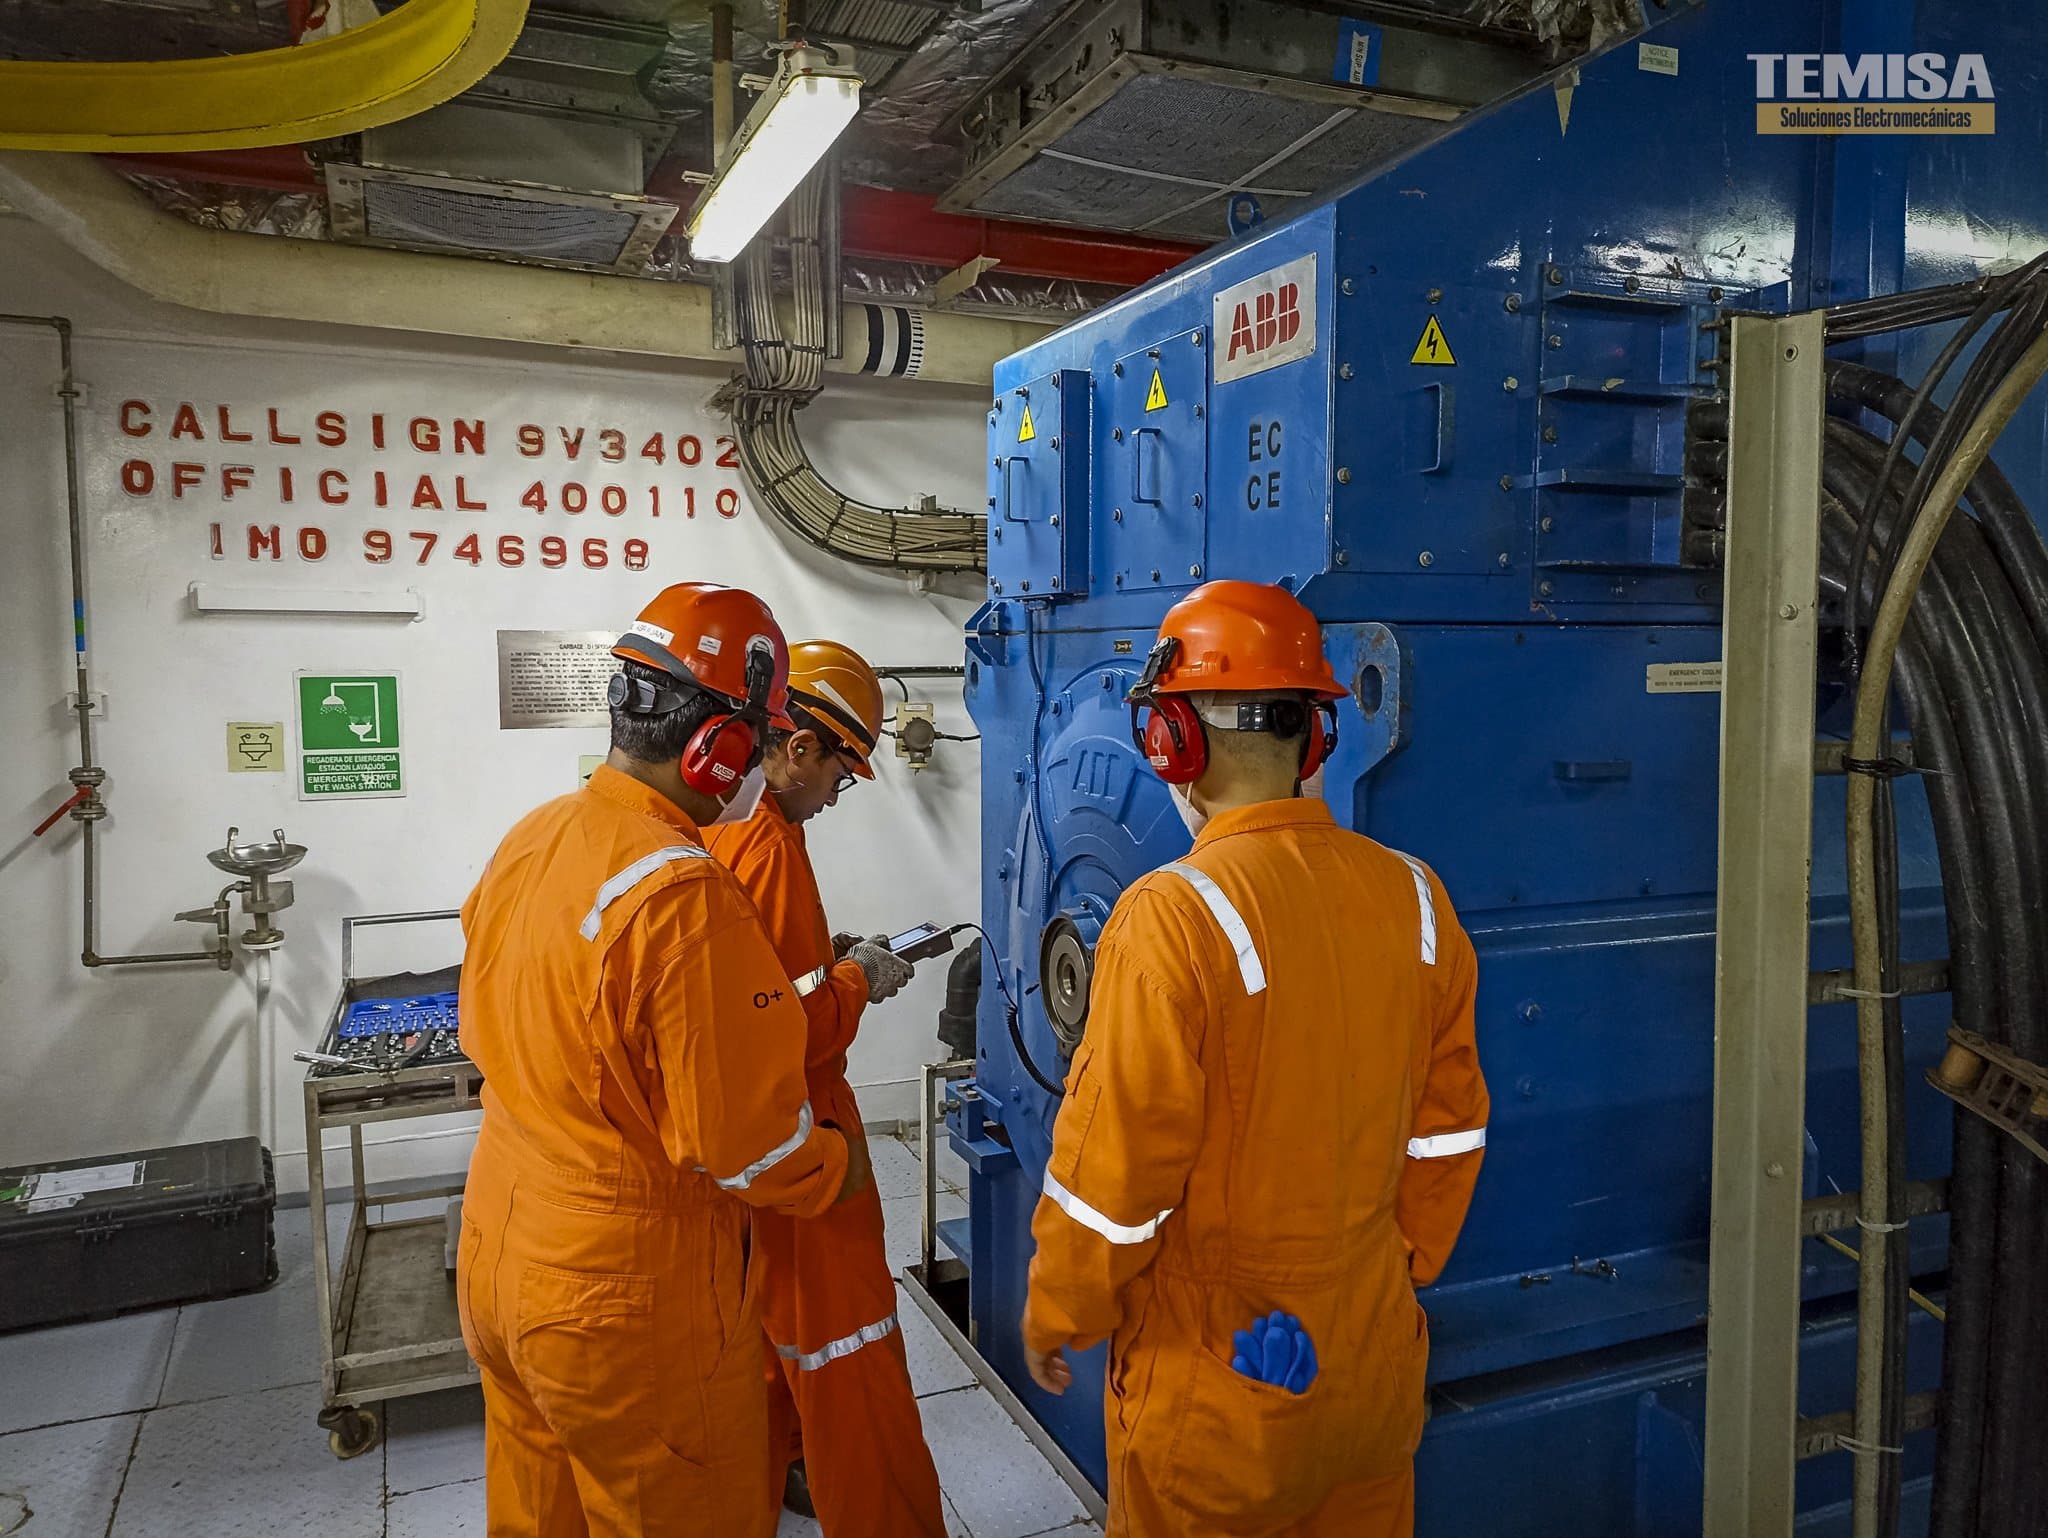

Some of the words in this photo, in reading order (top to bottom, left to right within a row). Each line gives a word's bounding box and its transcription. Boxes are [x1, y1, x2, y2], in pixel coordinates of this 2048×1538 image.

[1227, 282, 1301, 362] ABB
[120, 400, 486, 456] CALLSIGN
[516, 423, 741, 470] 9V3402
[1248, 421, 1282, 462] EC
[120, 459, 487, 511] OFFICIAL
[520, 480, 741, 519] 400110
[1247, 471, 1281, 511] CE
[210, 522, 328, 563] IMO
[362, 529, 650, 571] 9746968
[307, 756, 344, 764] REGADERA
[354, 755, 397, 763] EMERGENCIA
[307, 775, 359, 783] EMERGENCY
[319, 764, 351, 772] ESTACION
[314, 784, 330, 792] EYE
[332, 783, 357, 791] WASH
[358, 782, 392, 790] STATION
